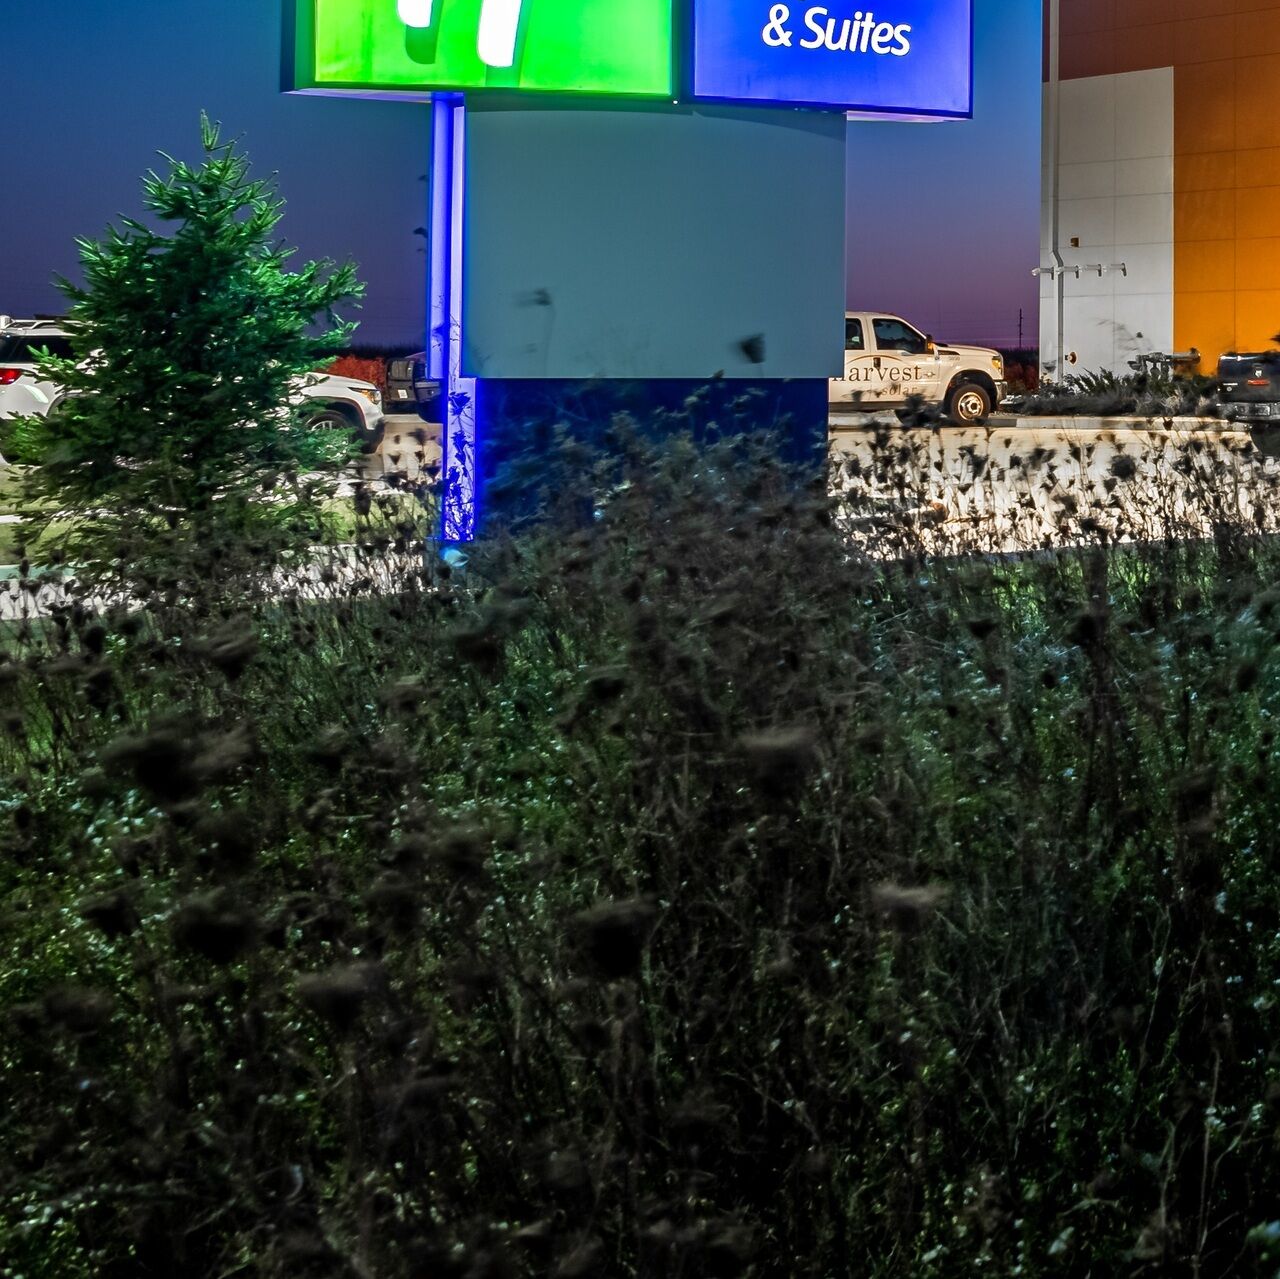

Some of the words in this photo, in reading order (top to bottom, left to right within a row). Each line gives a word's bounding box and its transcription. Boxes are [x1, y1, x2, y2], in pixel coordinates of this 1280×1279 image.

[762, 3, 792, 47] &
[800, 6, 912, 56] Suites
[832, 365, 922, 381] arvest
